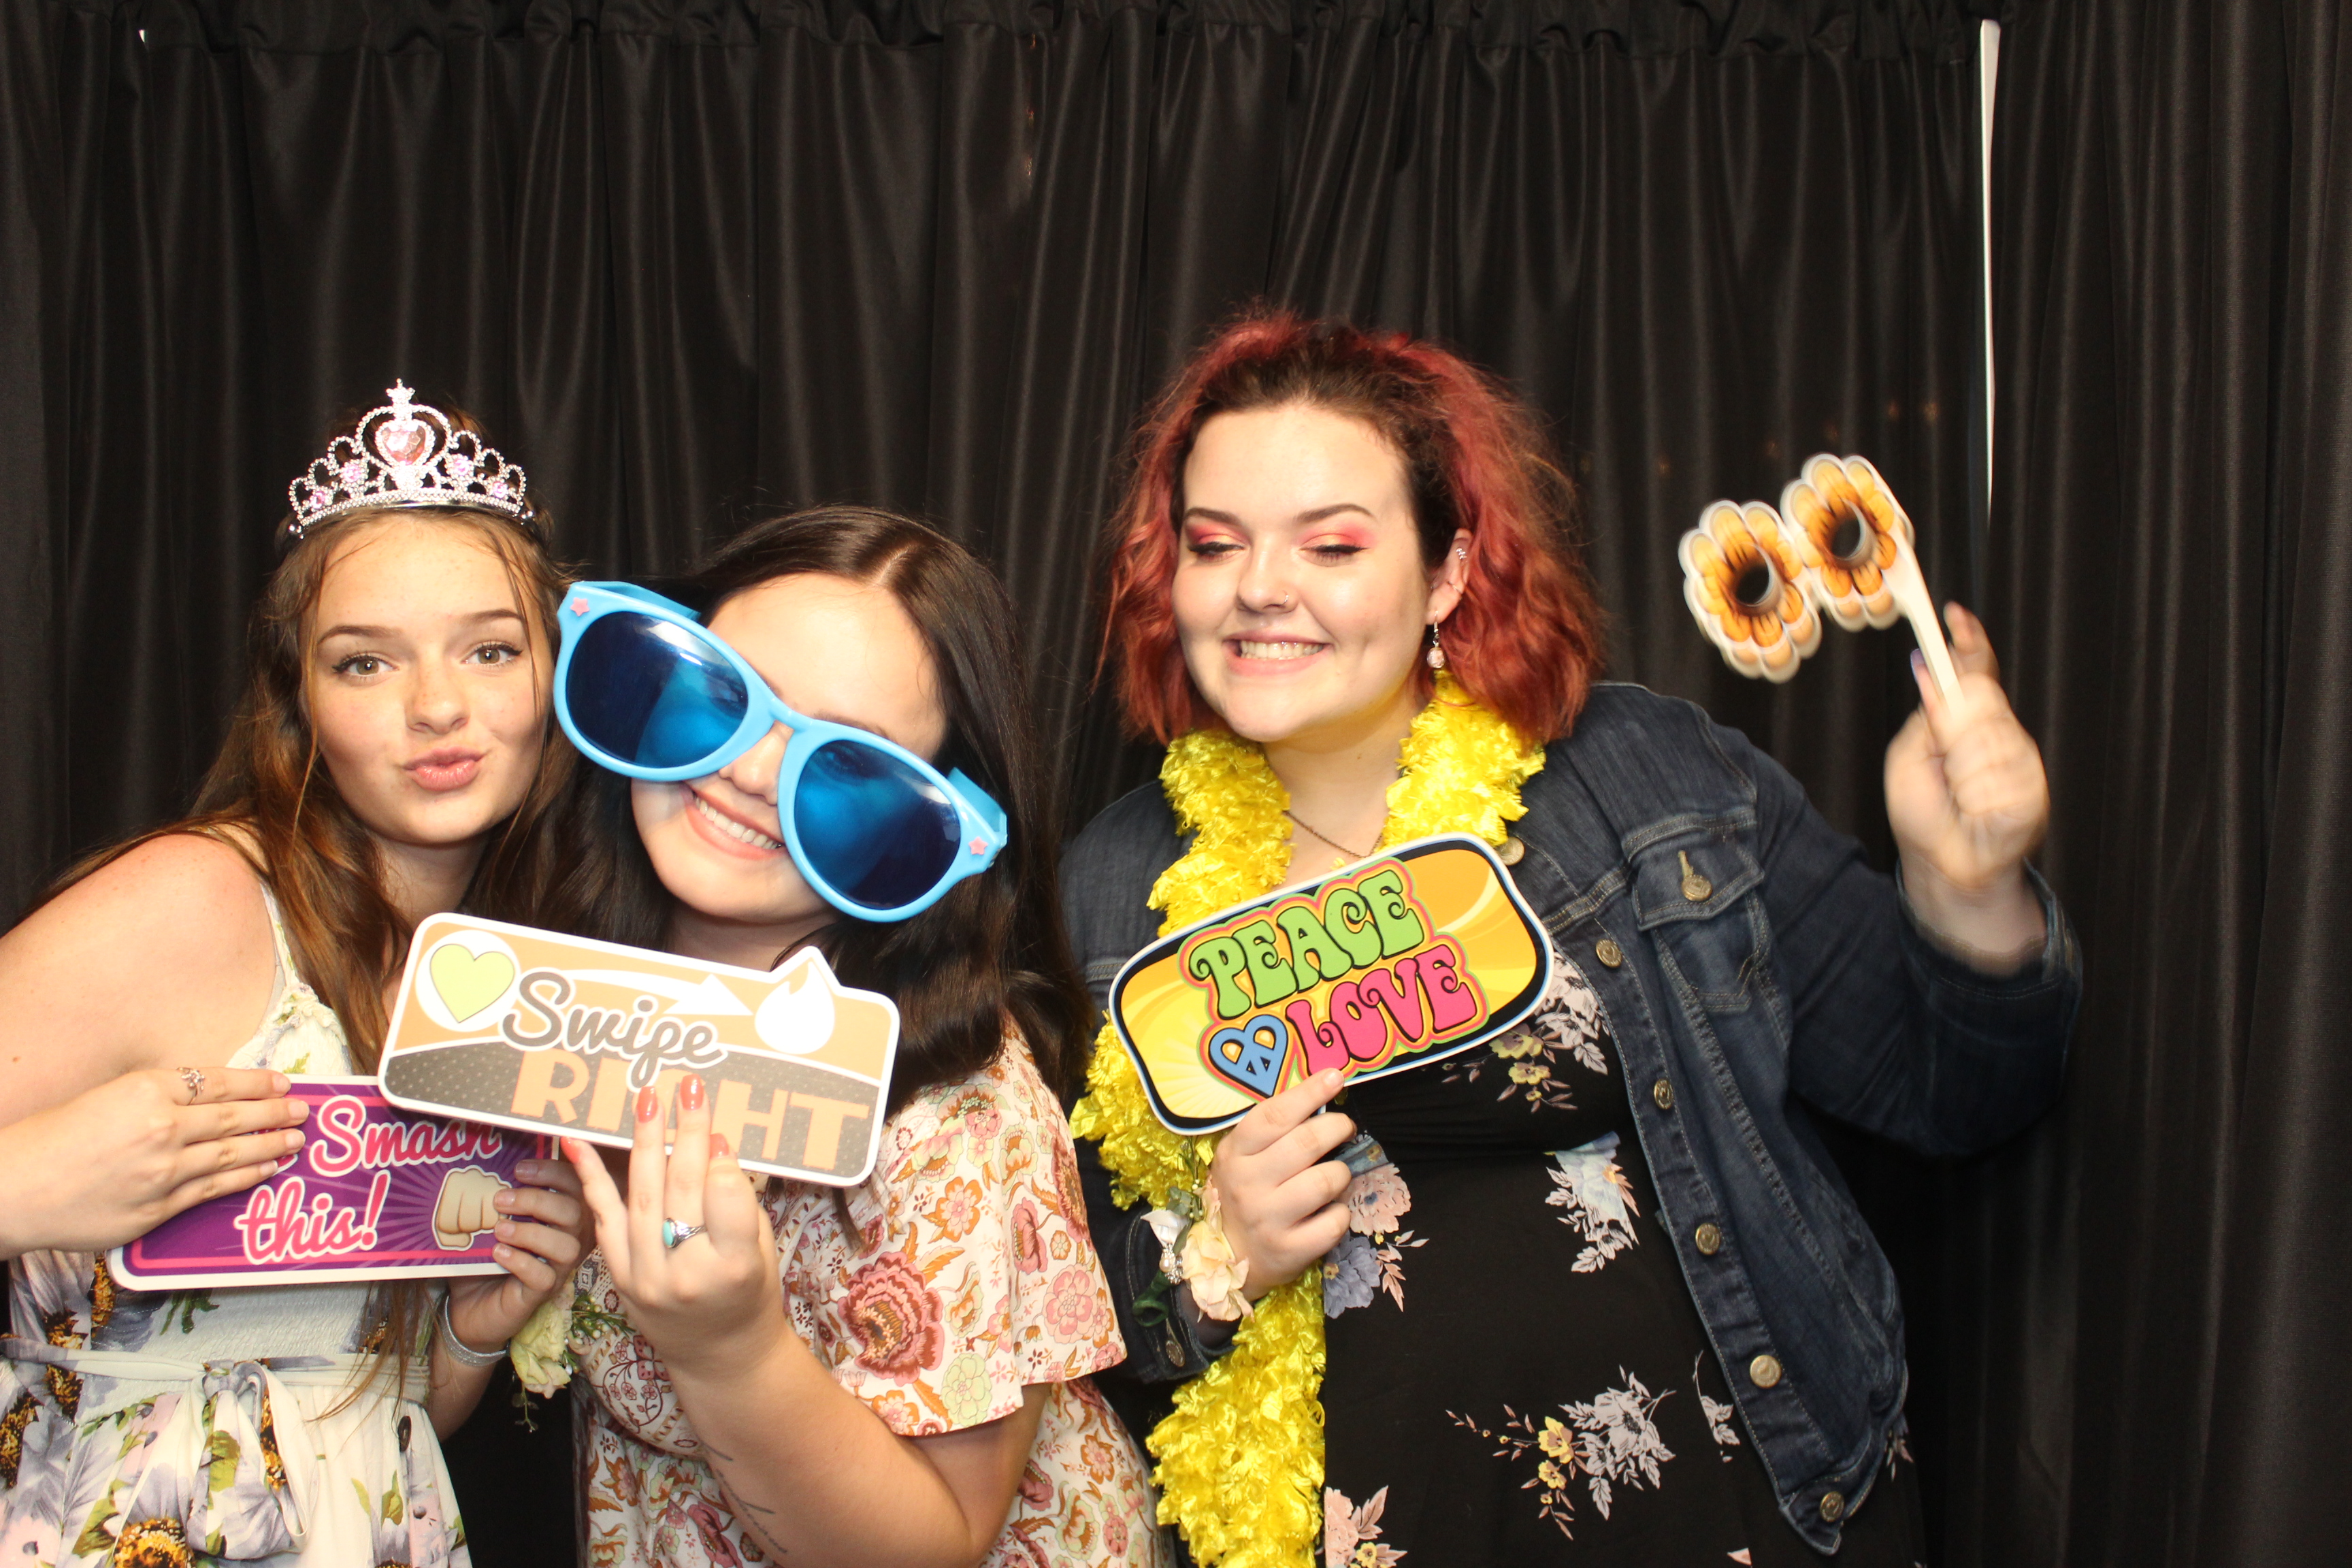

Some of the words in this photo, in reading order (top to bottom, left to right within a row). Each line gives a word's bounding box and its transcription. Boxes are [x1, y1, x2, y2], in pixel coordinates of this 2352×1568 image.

[1188, 870, 1424, 1018] PEACE
[502, 971, 724, 1089] Swipe
[1286, 944, 1478, 1076] LOVE
[238, 1172, 389, 1263] this!
